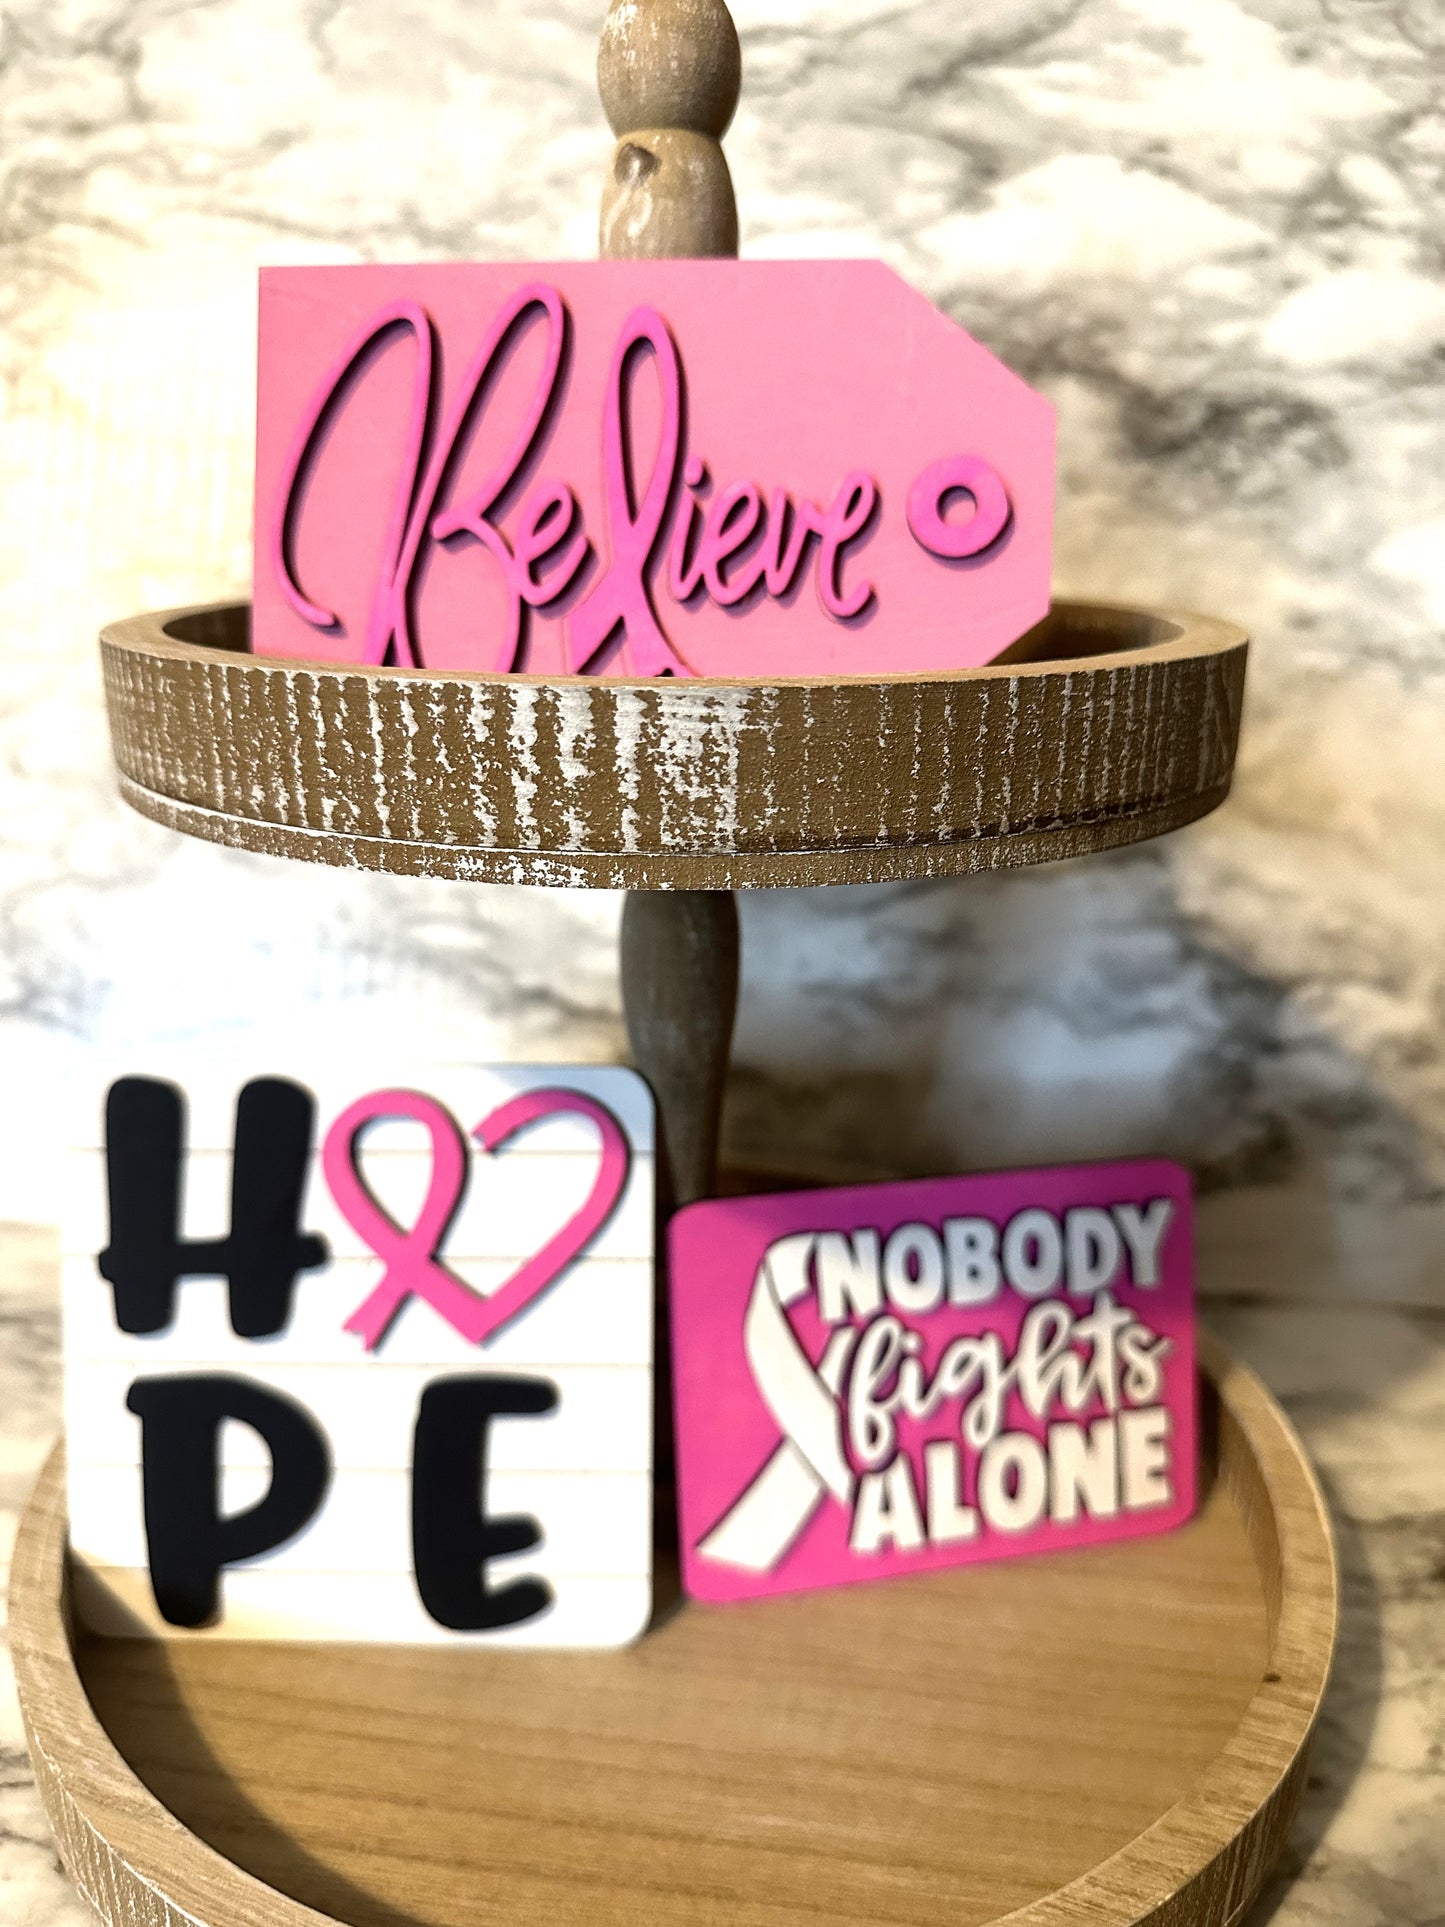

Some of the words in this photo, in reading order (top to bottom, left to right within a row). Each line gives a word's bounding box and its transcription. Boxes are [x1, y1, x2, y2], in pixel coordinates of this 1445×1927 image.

[280, 283, 877, 676] Believe
[814, 1199, 1173, 1323] NOBODY
[848, 1290, 1173, 1467] fights
[849, 1406, 1171, 1554] ALONE
